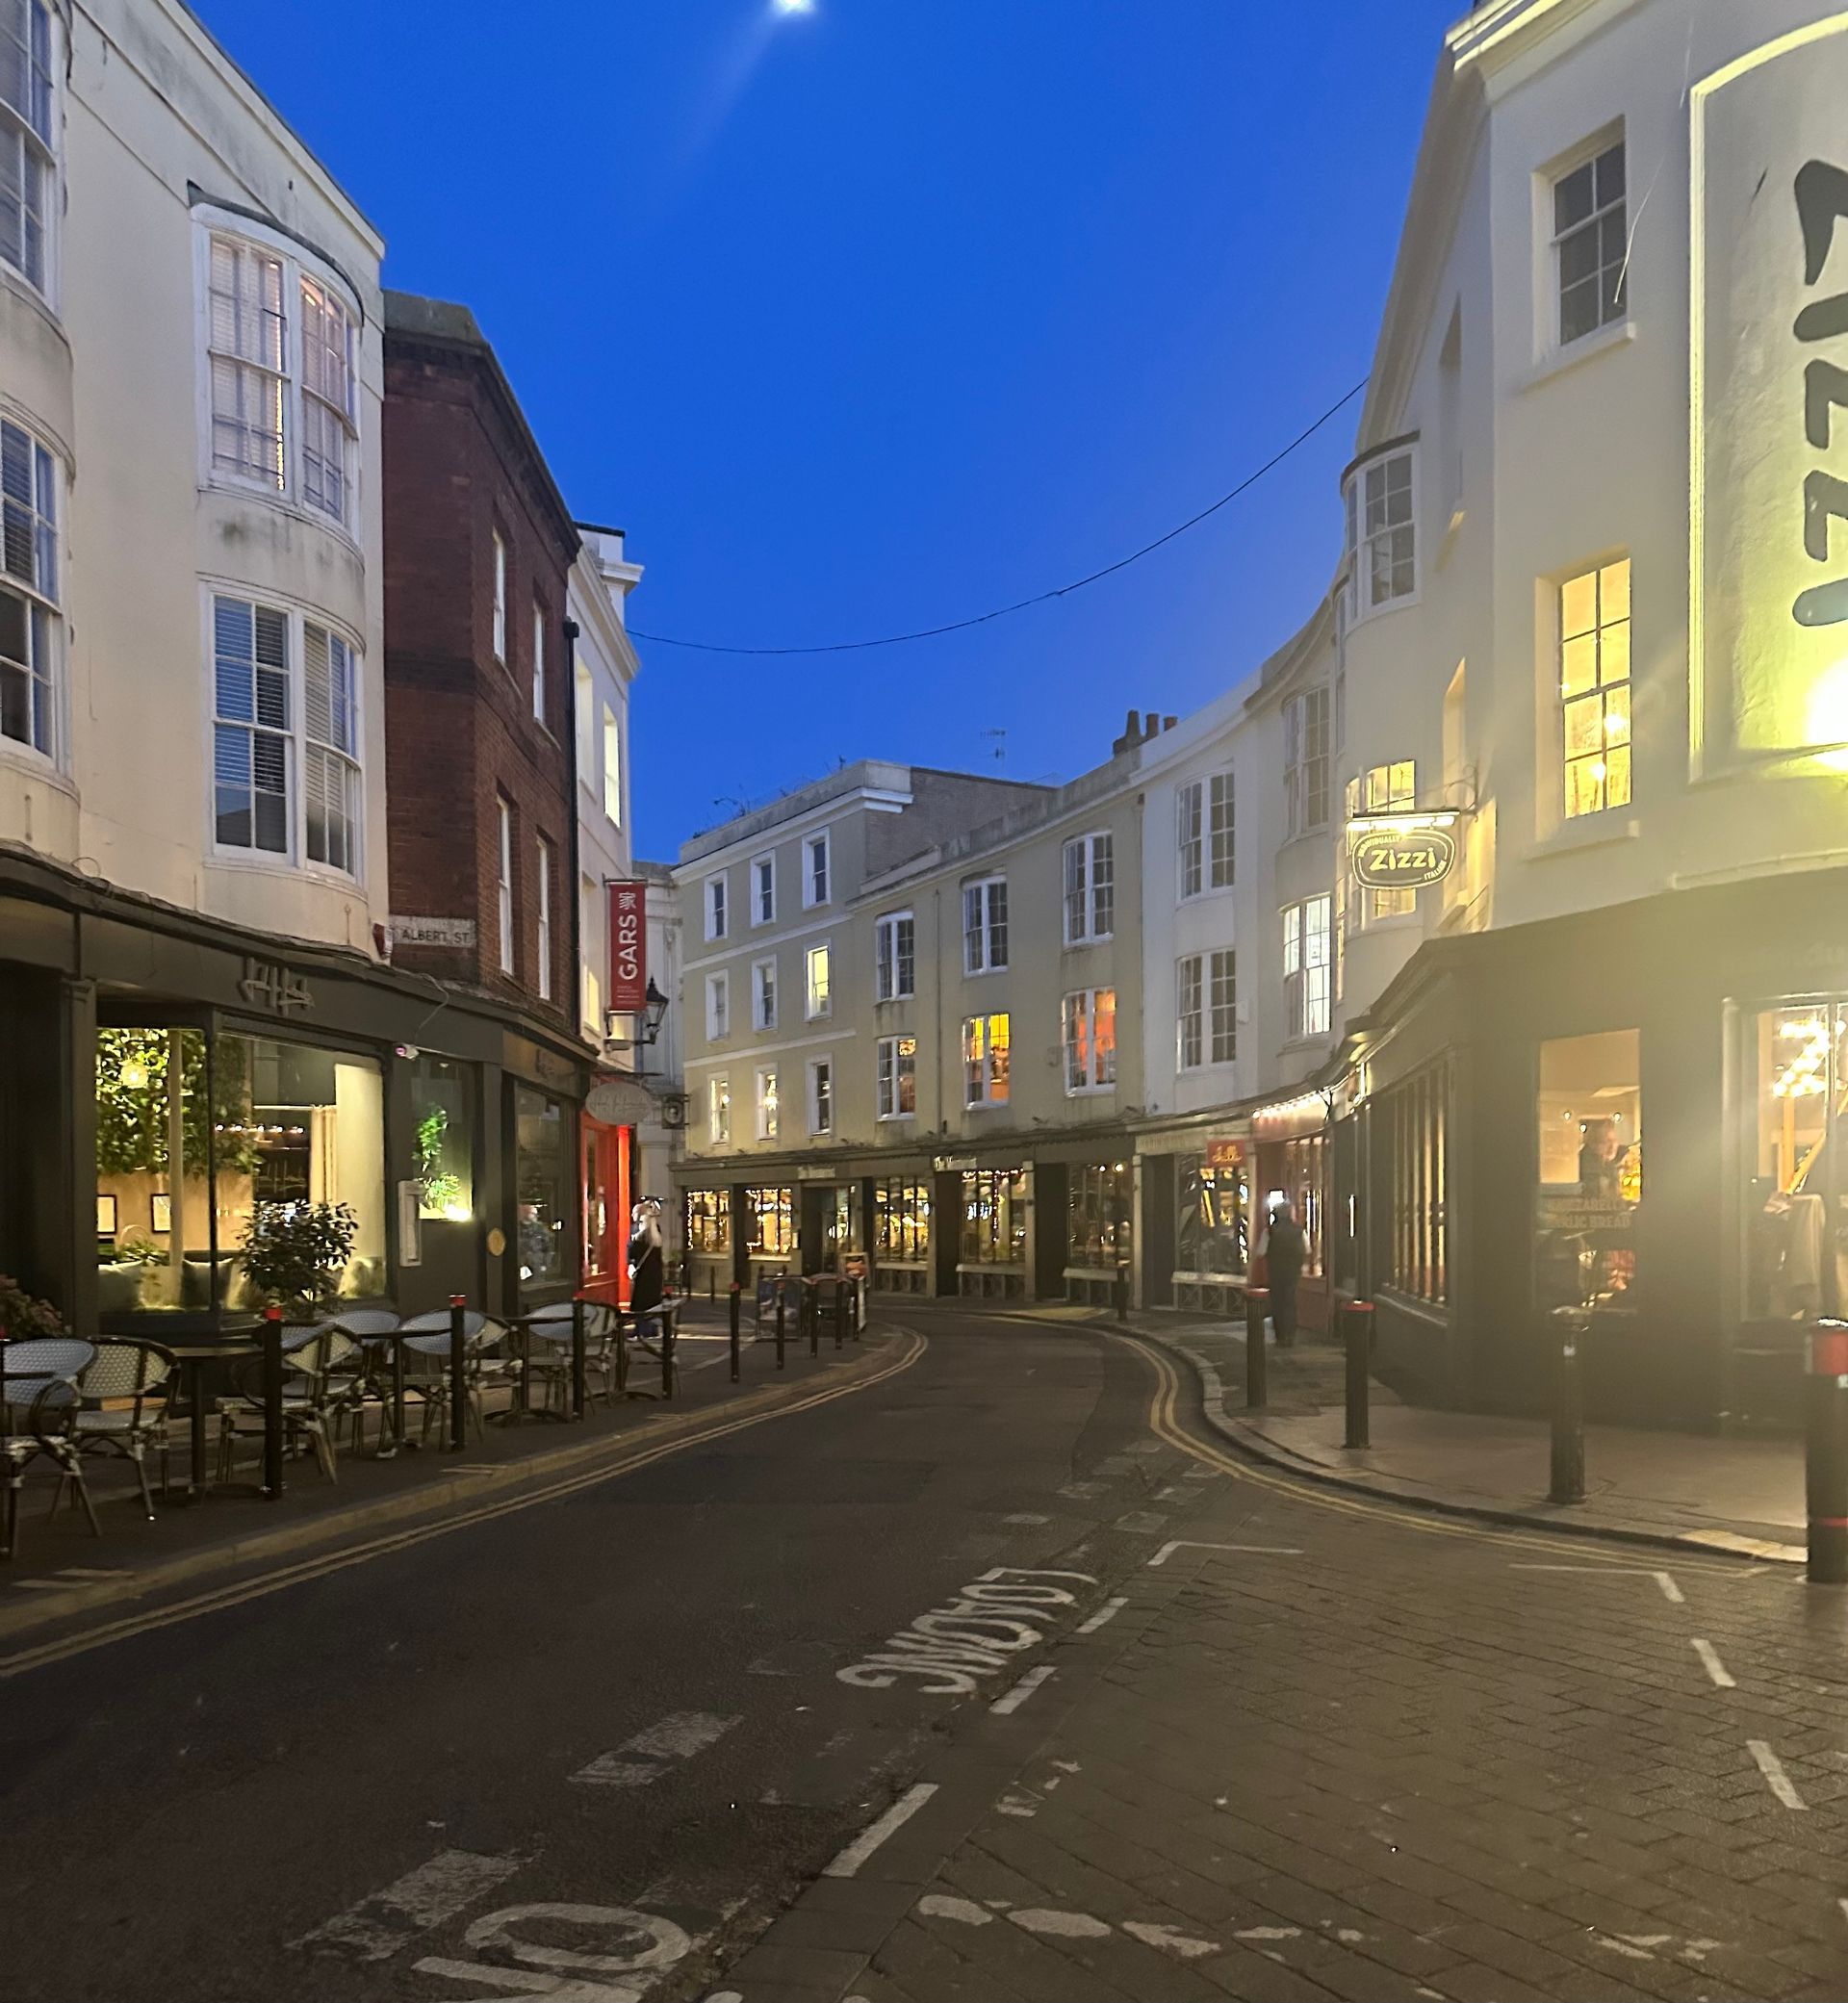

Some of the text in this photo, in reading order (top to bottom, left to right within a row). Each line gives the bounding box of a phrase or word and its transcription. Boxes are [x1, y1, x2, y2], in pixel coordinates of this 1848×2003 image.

[1369, 847, 1436, 871] Zizzi
[618, 891, 637, 911] 家
[401, 928, 471, 944] ALBERT ST
[617, 913, 638, 981] GARS
[834, 1566, 1099, 1695] LOADING
